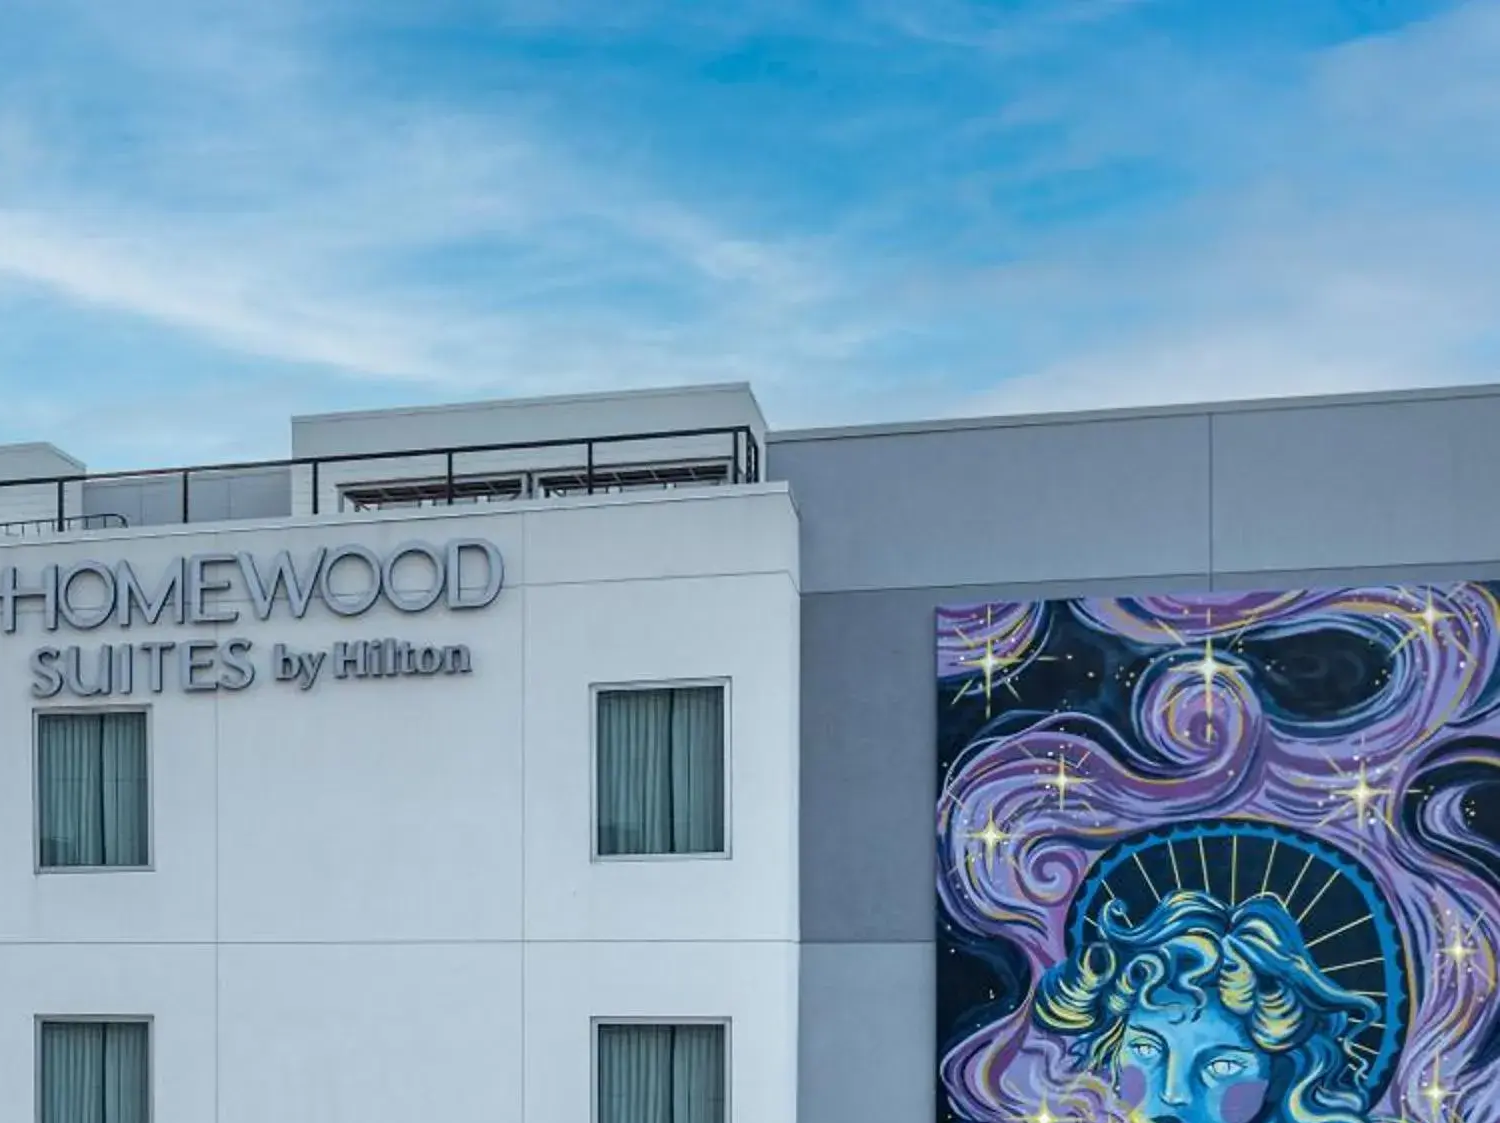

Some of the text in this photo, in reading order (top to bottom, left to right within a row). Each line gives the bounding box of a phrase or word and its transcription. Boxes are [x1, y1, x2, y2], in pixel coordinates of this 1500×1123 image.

[30, 637, 472, 697] SUITES by Hilton
